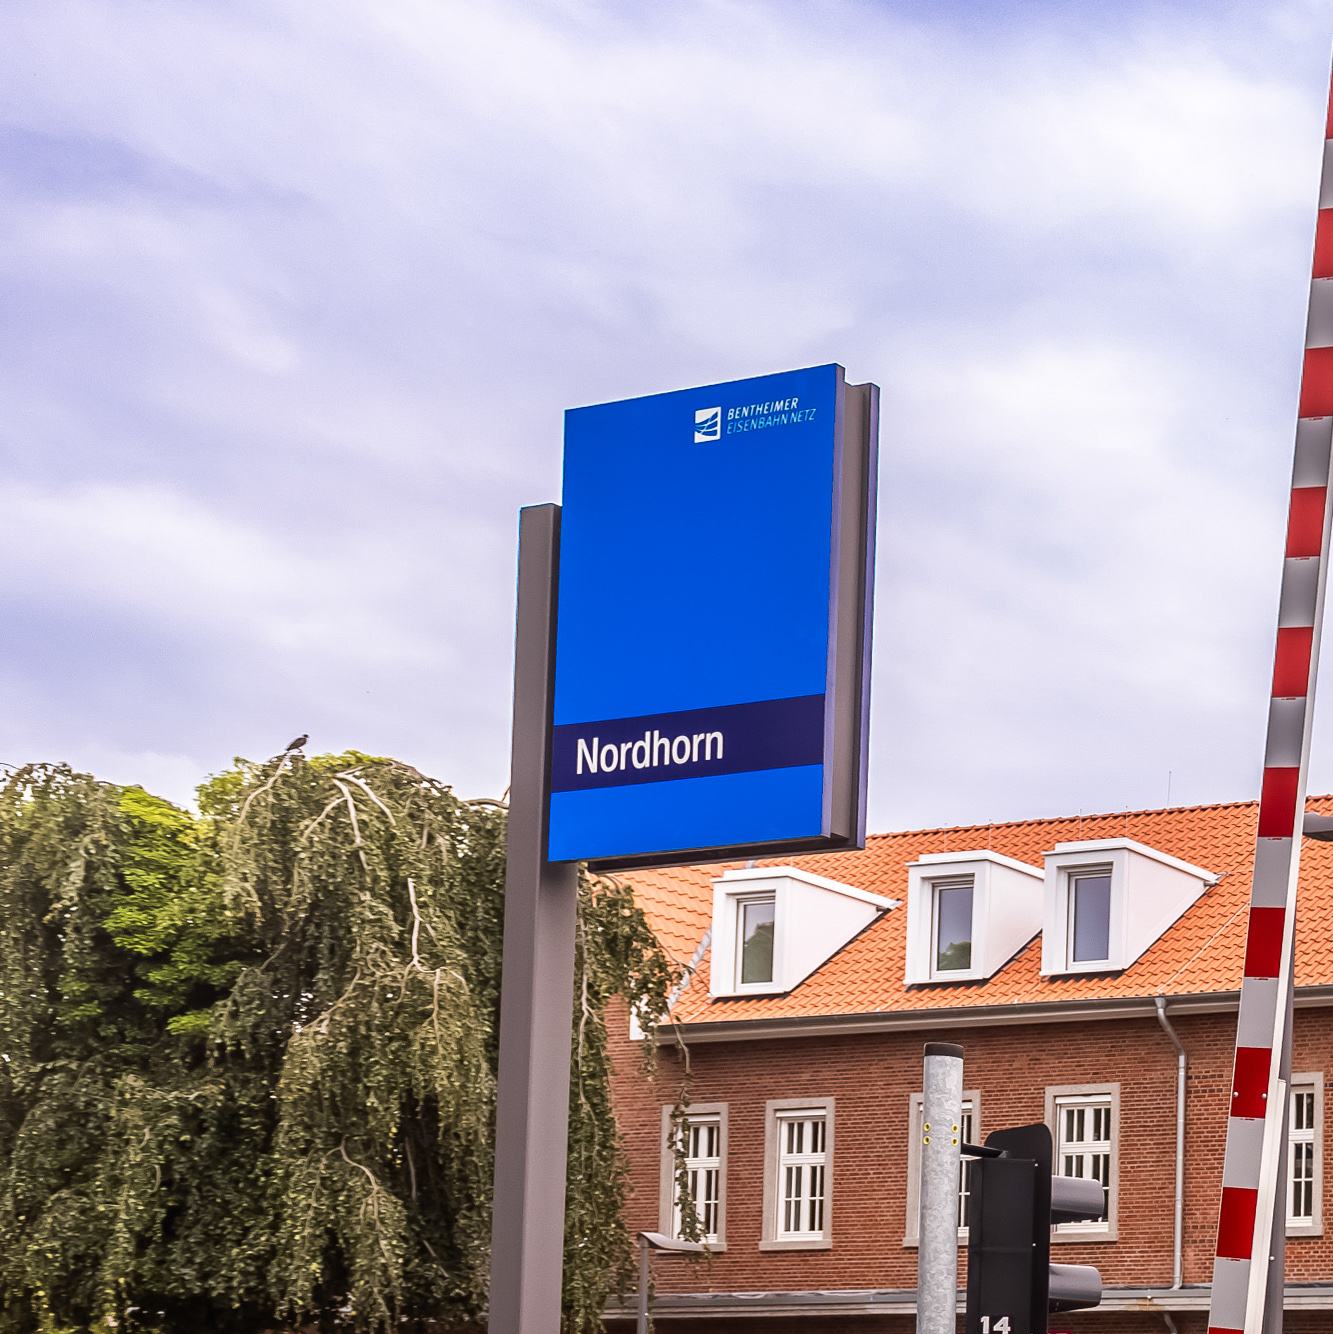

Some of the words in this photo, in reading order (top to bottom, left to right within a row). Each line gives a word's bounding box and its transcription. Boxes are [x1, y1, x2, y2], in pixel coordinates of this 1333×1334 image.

[727, 397, 799, 420] BENTHEIMER
[726, 413, 788, 435] EISENBAHN
[790, 408, 817, 423] NETZ
[576, 729, 724, 775] Nordhorn
[980, 1315, 1011, 1334] 14
